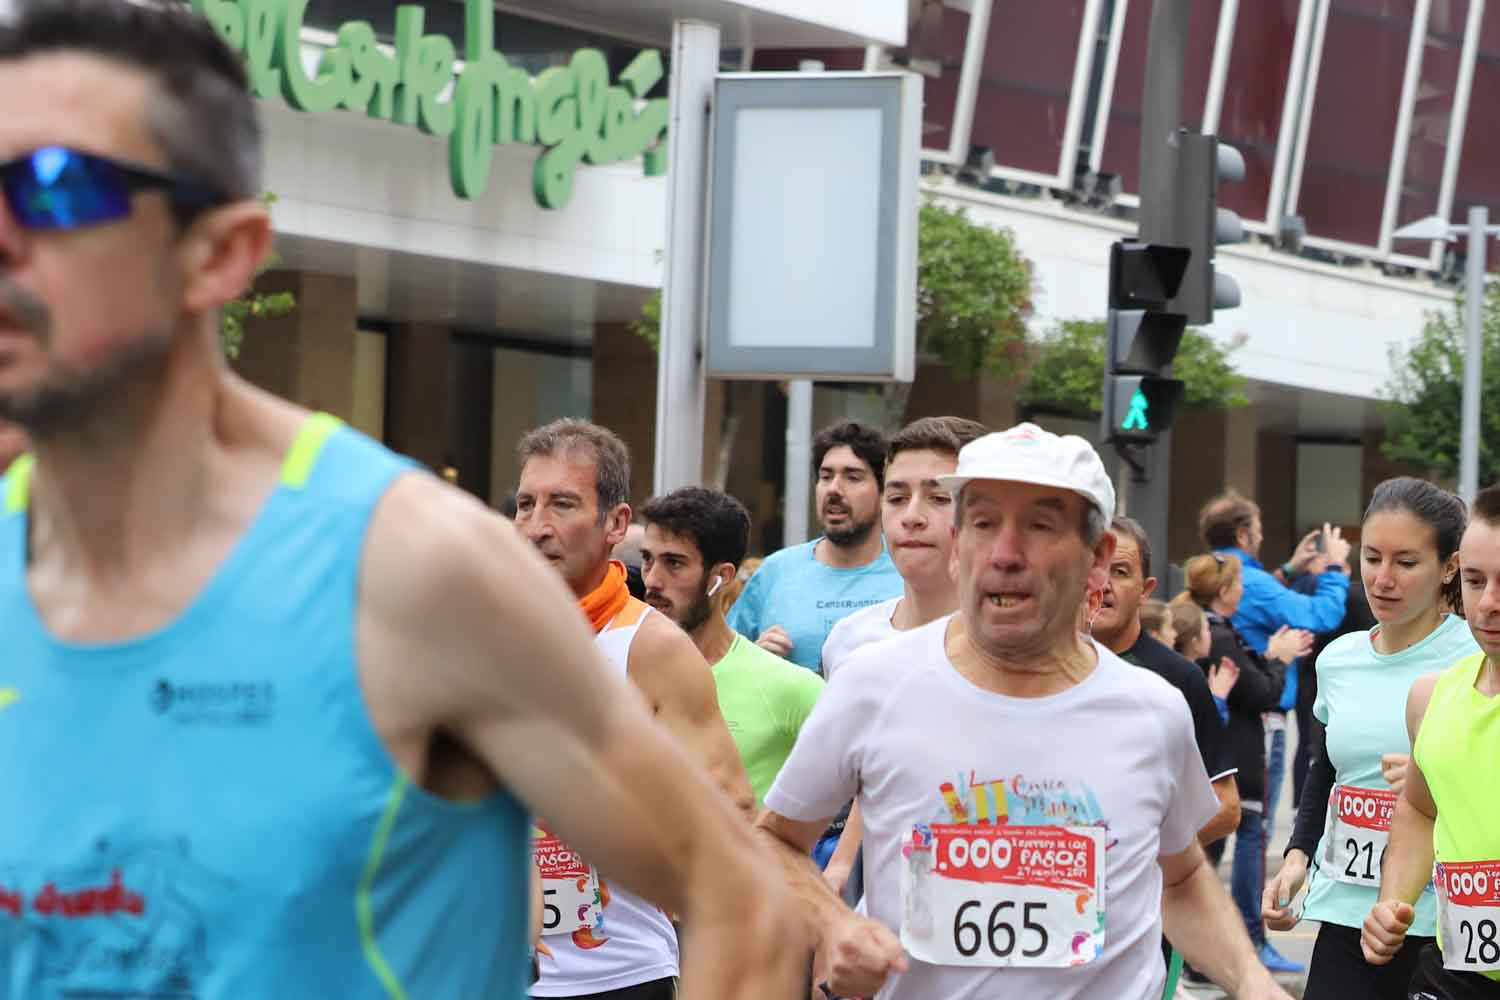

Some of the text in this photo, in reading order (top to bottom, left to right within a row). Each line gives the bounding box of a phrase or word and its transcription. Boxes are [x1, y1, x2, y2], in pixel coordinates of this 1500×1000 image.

[931, 837, 1012, 870] 1.000
[1020, 849, 1088, 868] PASOS
[1444, 872, 1487, 897] 1.000
[954, 900, 1049, 957] 665
